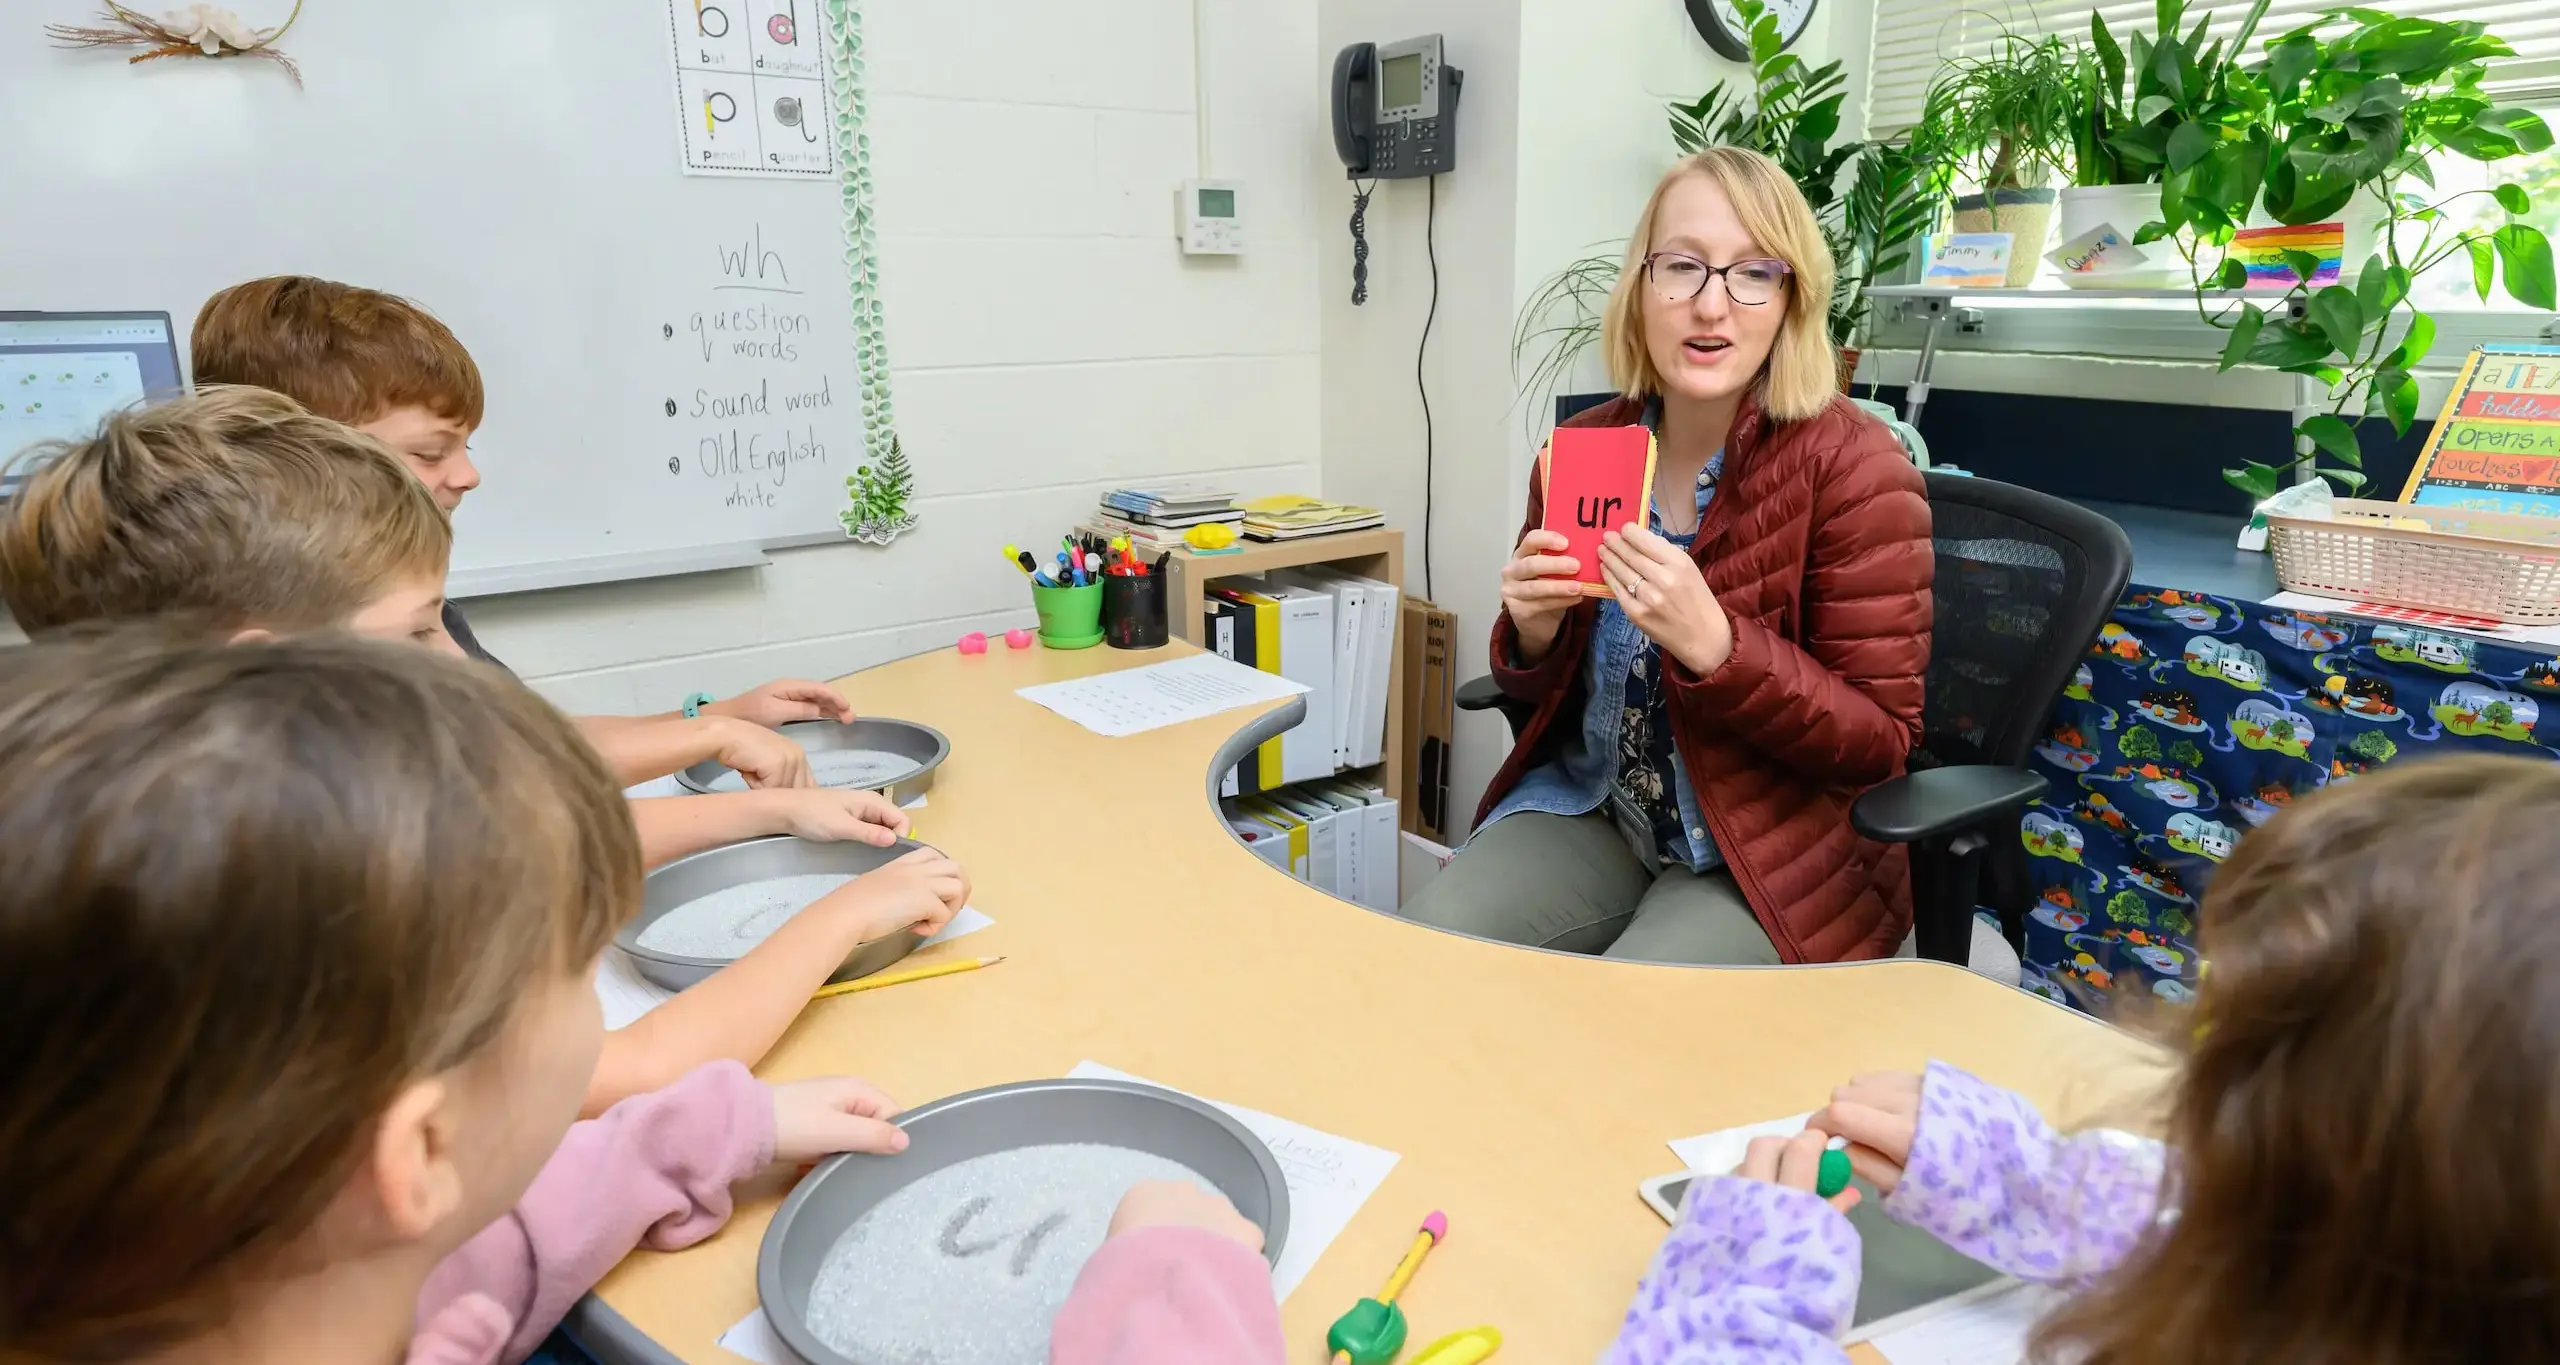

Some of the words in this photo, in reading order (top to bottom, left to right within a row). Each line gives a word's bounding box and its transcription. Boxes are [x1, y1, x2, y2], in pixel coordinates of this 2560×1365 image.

[719, 222, 789, 284] wh
[690, 303, 811, 363] question
[733, 333, 798, 362] words
[785, 375, 833, 412] word
[700, 428, 744, 477] Old
[750, 423, 826, 487] English
[725, 481, 776, 508] white
[1577, 496, 1622, 528] ur
